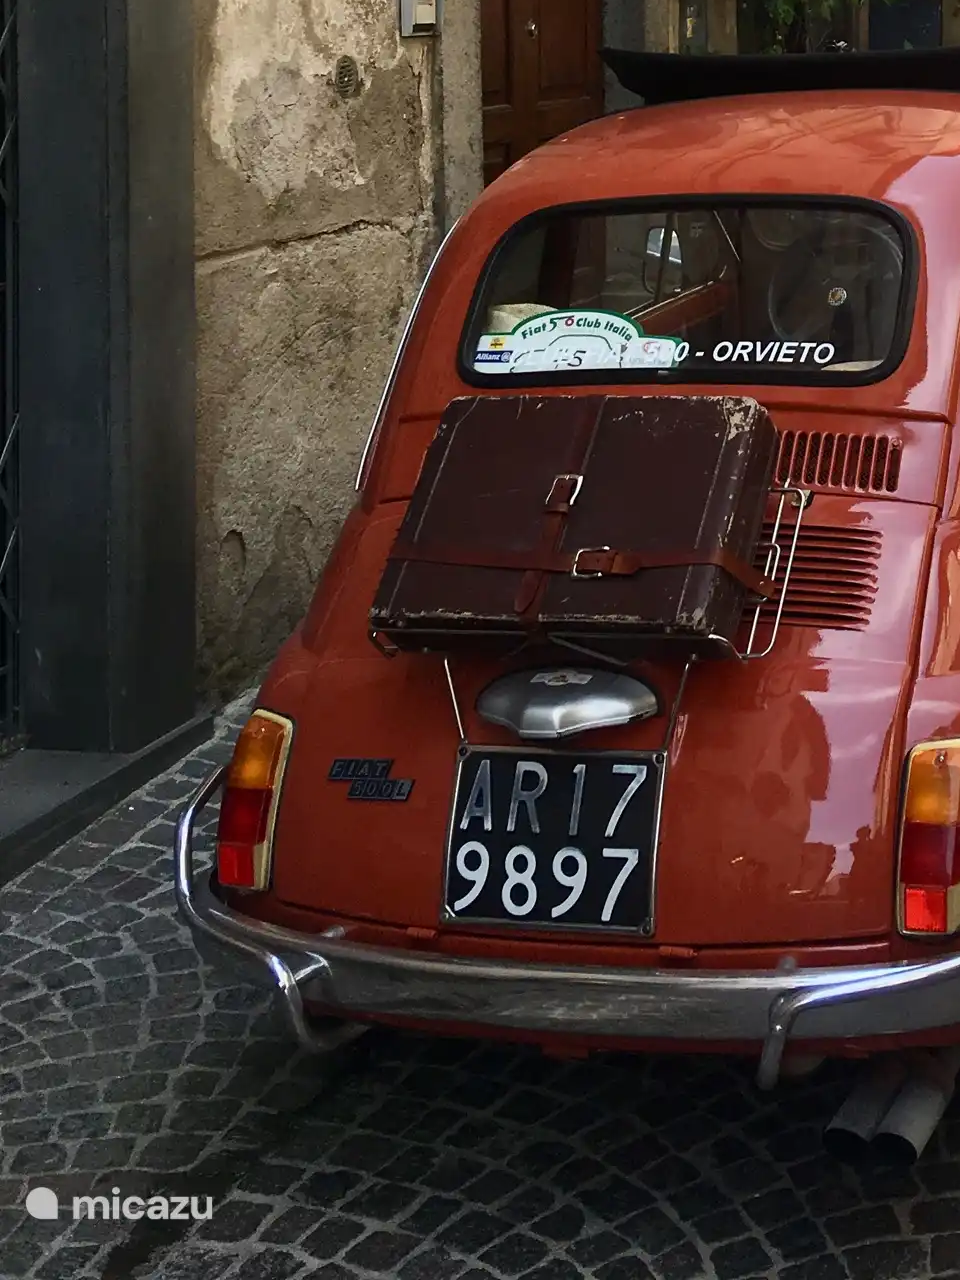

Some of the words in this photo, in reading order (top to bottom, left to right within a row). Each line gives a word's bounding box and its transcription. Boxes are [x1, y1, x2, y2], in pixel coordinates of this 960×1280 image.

[521, 323, 546, 339] Fiat
[576, 317, 601, 328] Club
[604, 321, 632, 342] Italia
[475, 352, 501, 361] Allianz
[712, 340, 835, 364] ORVIETO
[331, 761, 389, 776] FIAT
[453, 841, 640, 922] 9897
